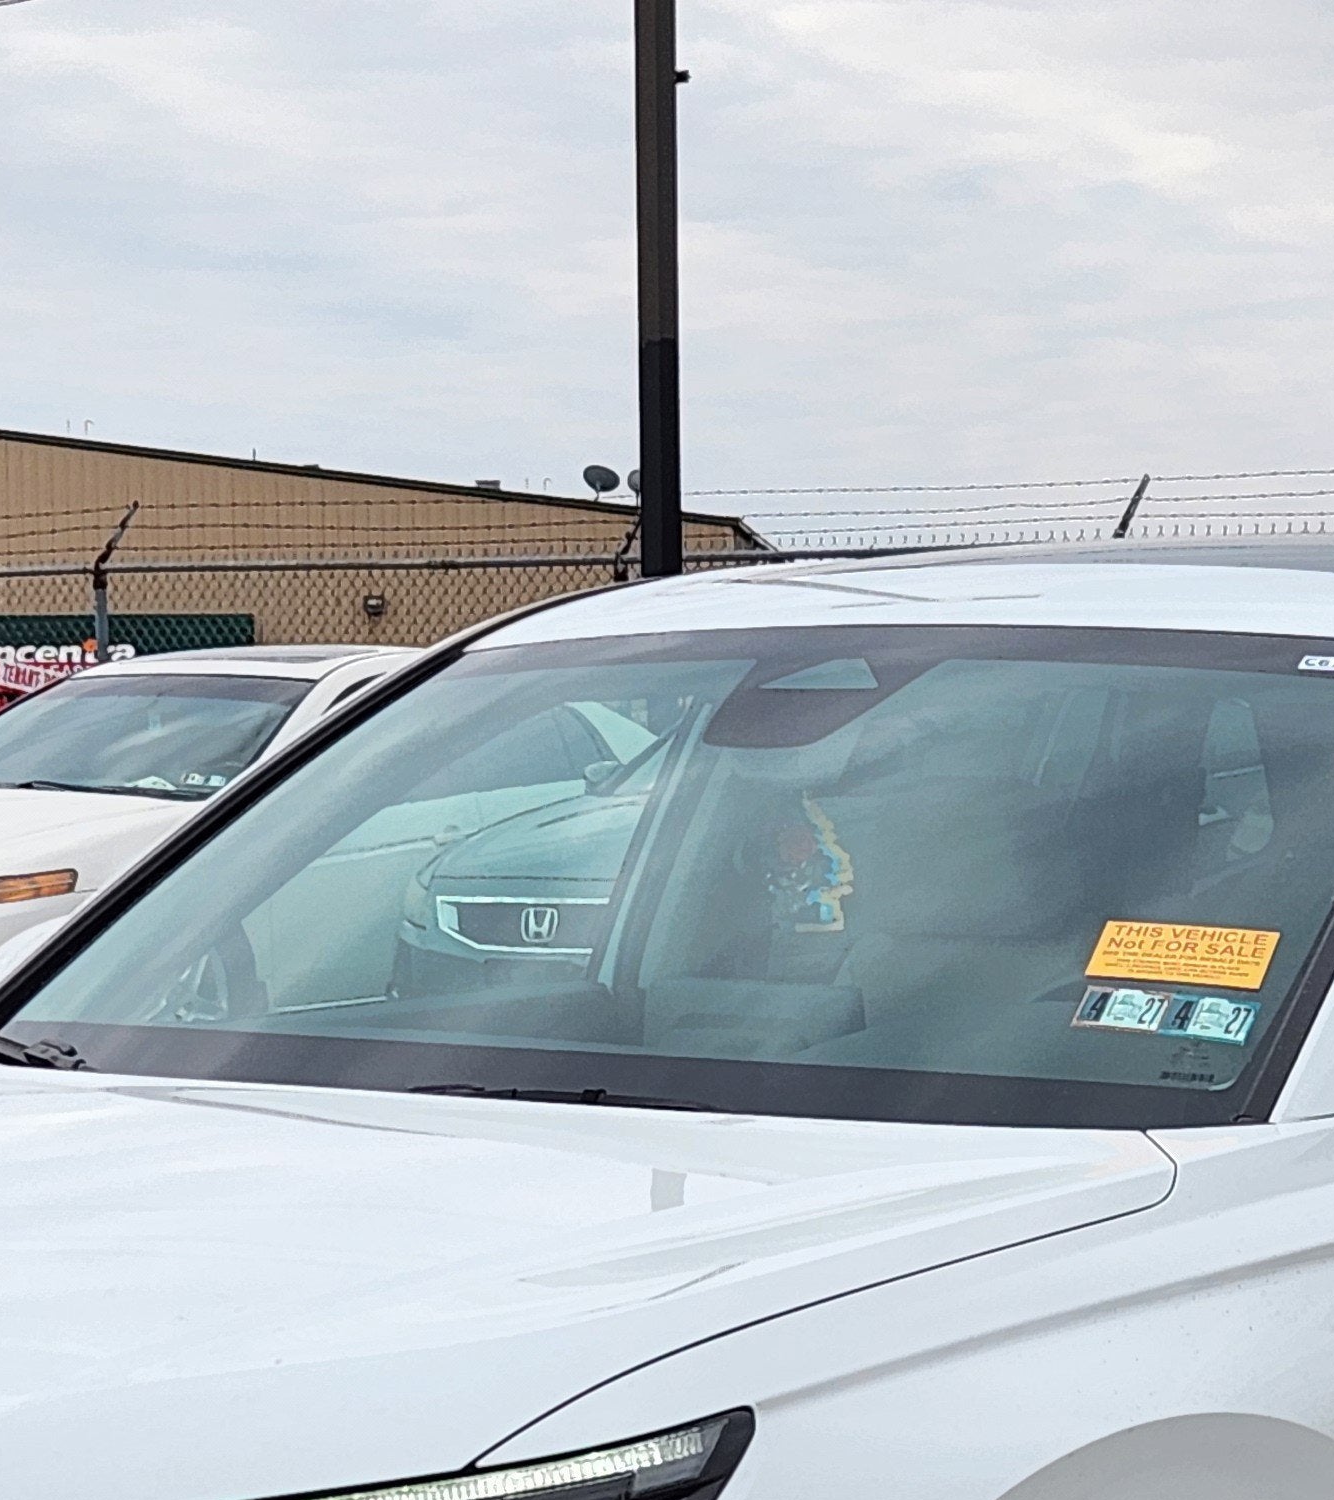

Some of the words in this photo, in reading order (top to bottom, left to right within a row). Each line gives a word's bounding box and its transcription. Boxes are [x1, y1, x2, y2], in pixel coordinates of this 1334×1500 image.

[1114, 924, 1163, 938] THIS
[1172, 927, 1269, 946] VEHICLE
[1151, 939, 1199, 953] FOR
[1205, 943, 1267, 959] SALE
[1137, 998, 1166, 1030] 27
[1224, 1006, 1253, 1039] 27
